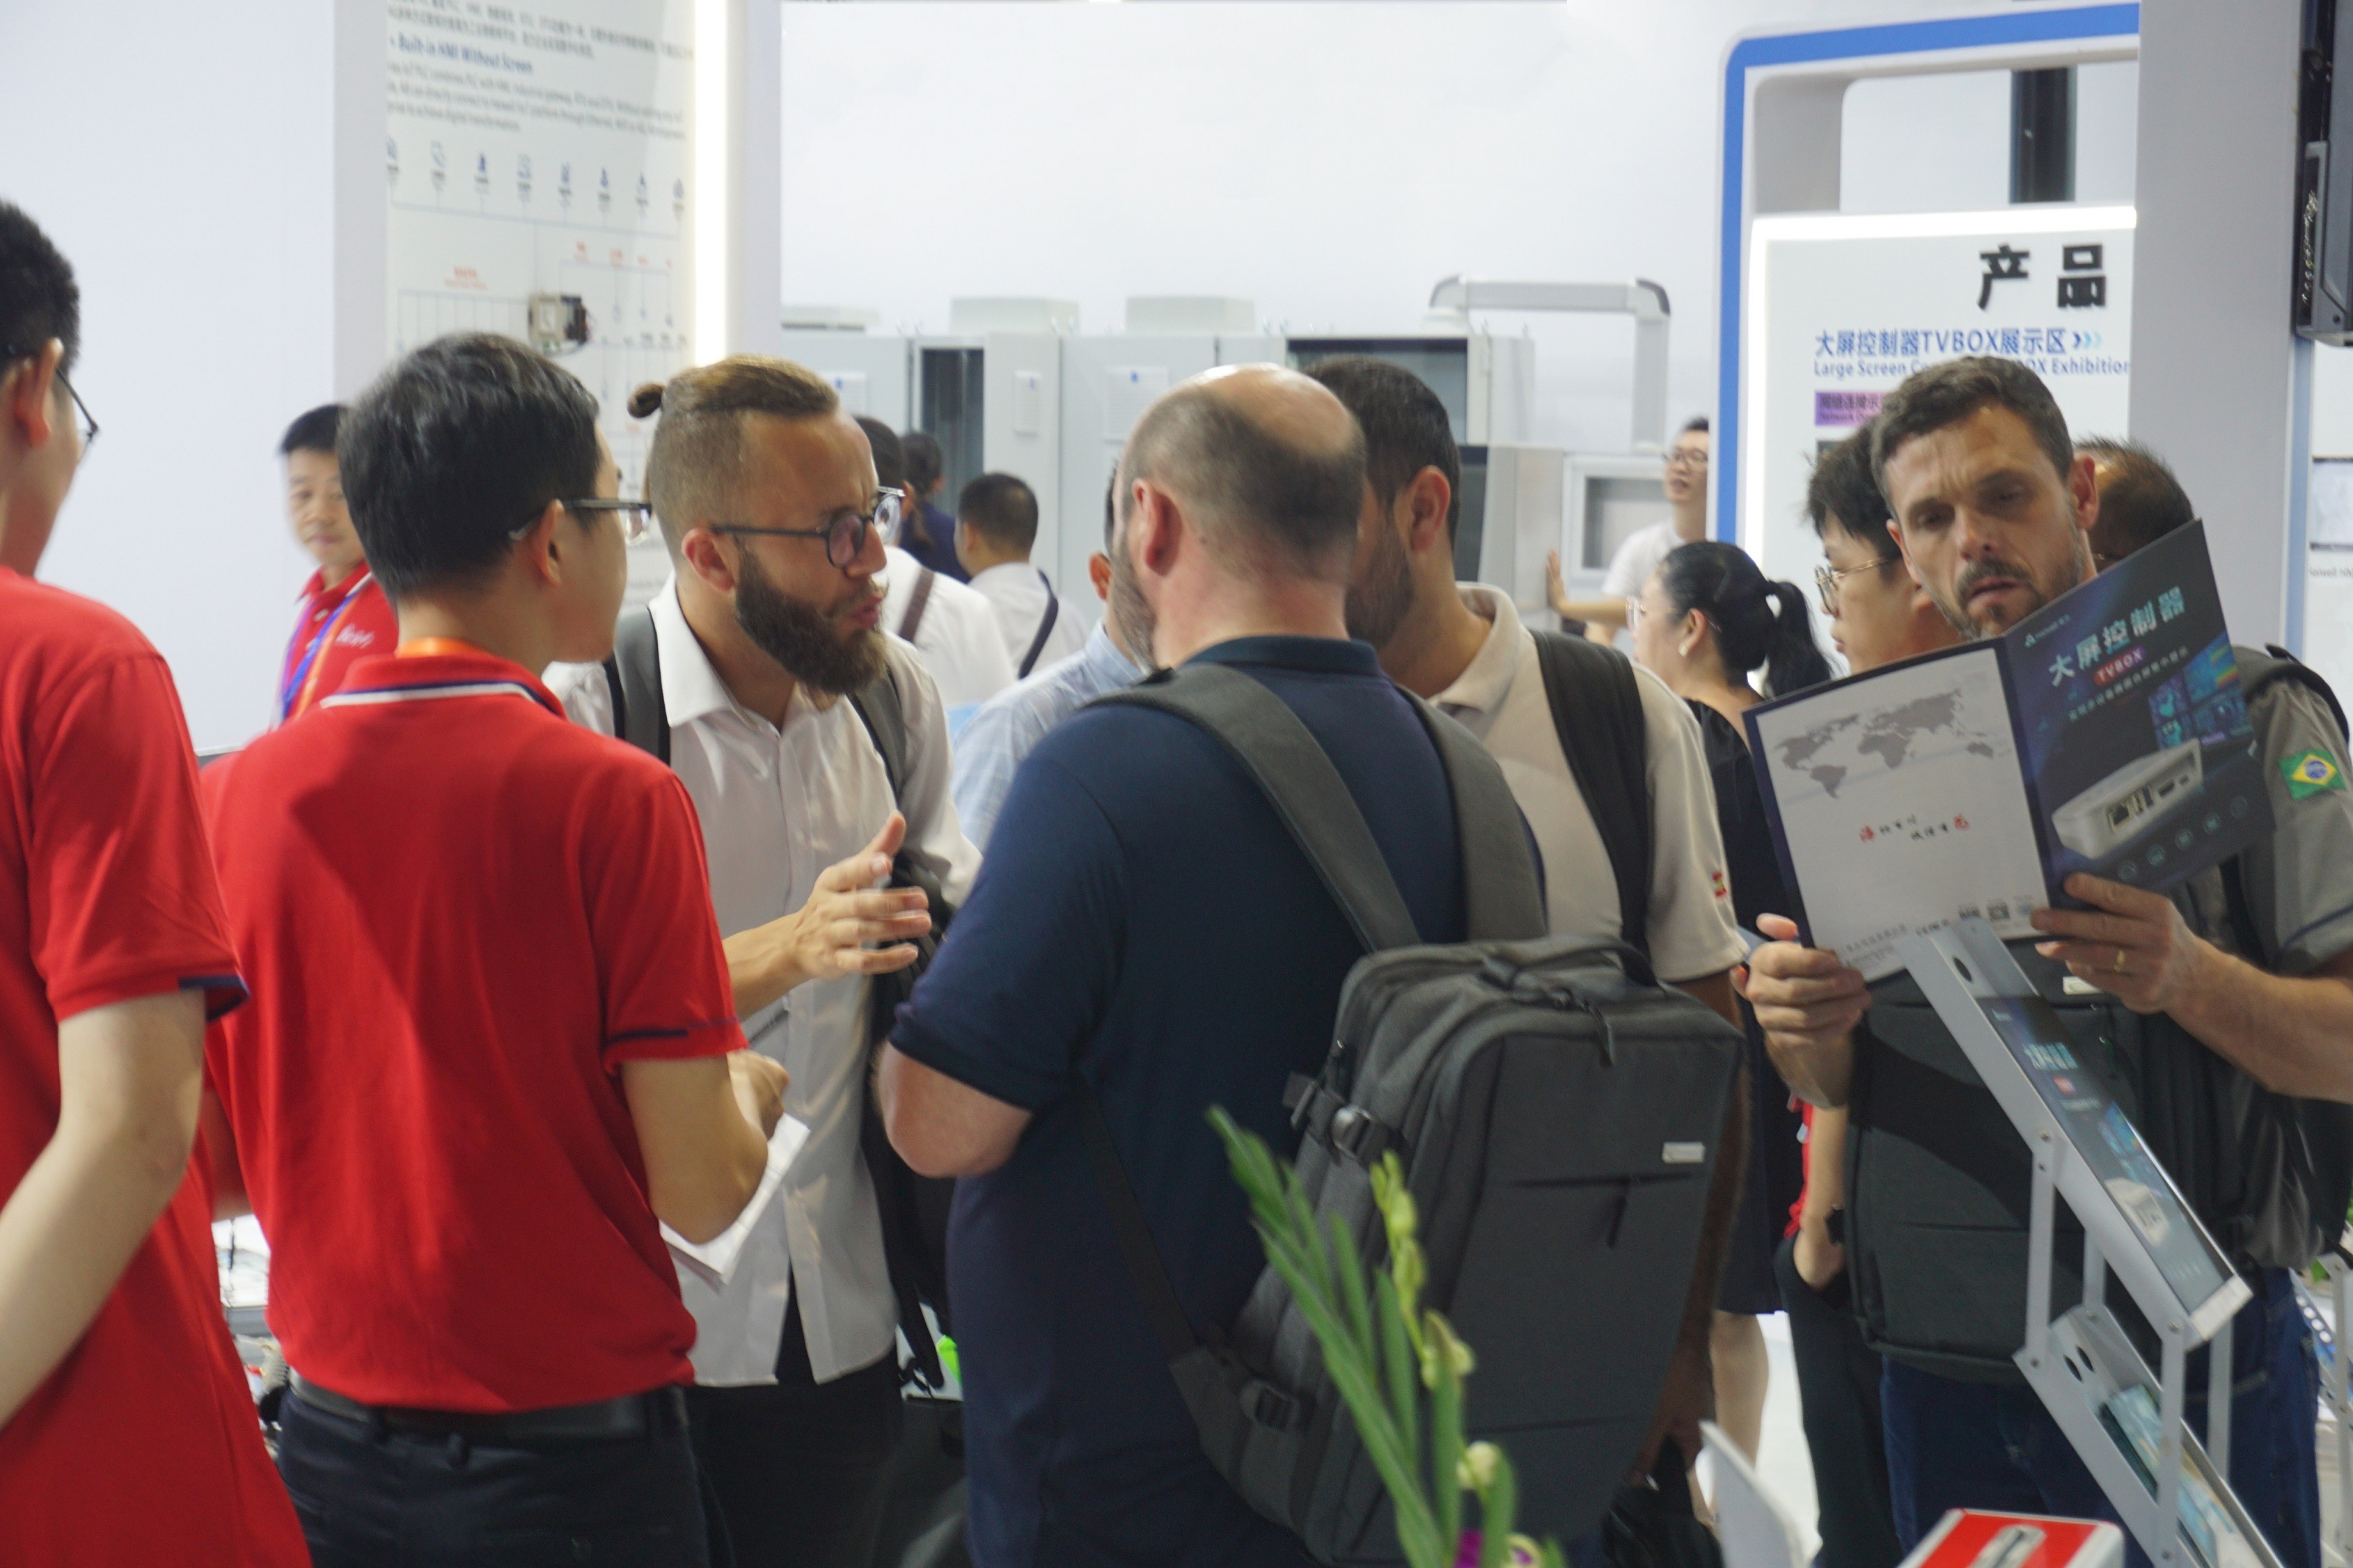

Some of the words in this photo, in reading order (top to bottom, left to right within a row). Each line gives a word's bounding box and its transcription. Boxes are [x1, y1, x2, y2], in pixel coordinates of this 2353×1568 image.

[1813, 358, 1853, 381] Large
[1857, 359, 1907, 377] Screen
[2048, 586, 2186, 688] 大屏控制器
[2096, 647, 2145, 683] TVBOX
